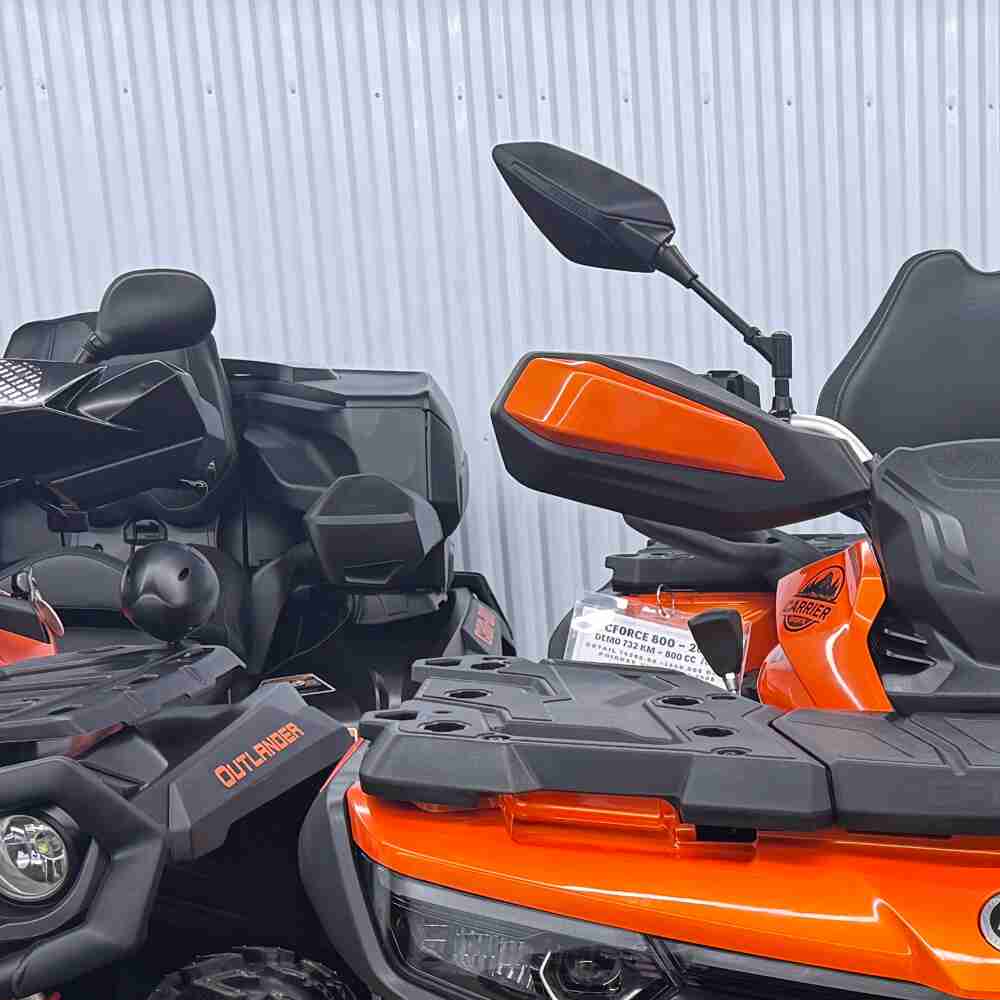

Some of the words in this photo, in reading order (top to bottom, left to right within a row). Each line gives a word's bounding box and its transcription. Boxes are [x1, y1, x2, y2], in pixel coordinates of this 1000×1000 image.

[594, 632, 621, 646] DEMO
[604, 624, 649, 642] CFORCE
[651, 634, 676, 648] 800
[213, 721, 305, 789] OUTLANDER
